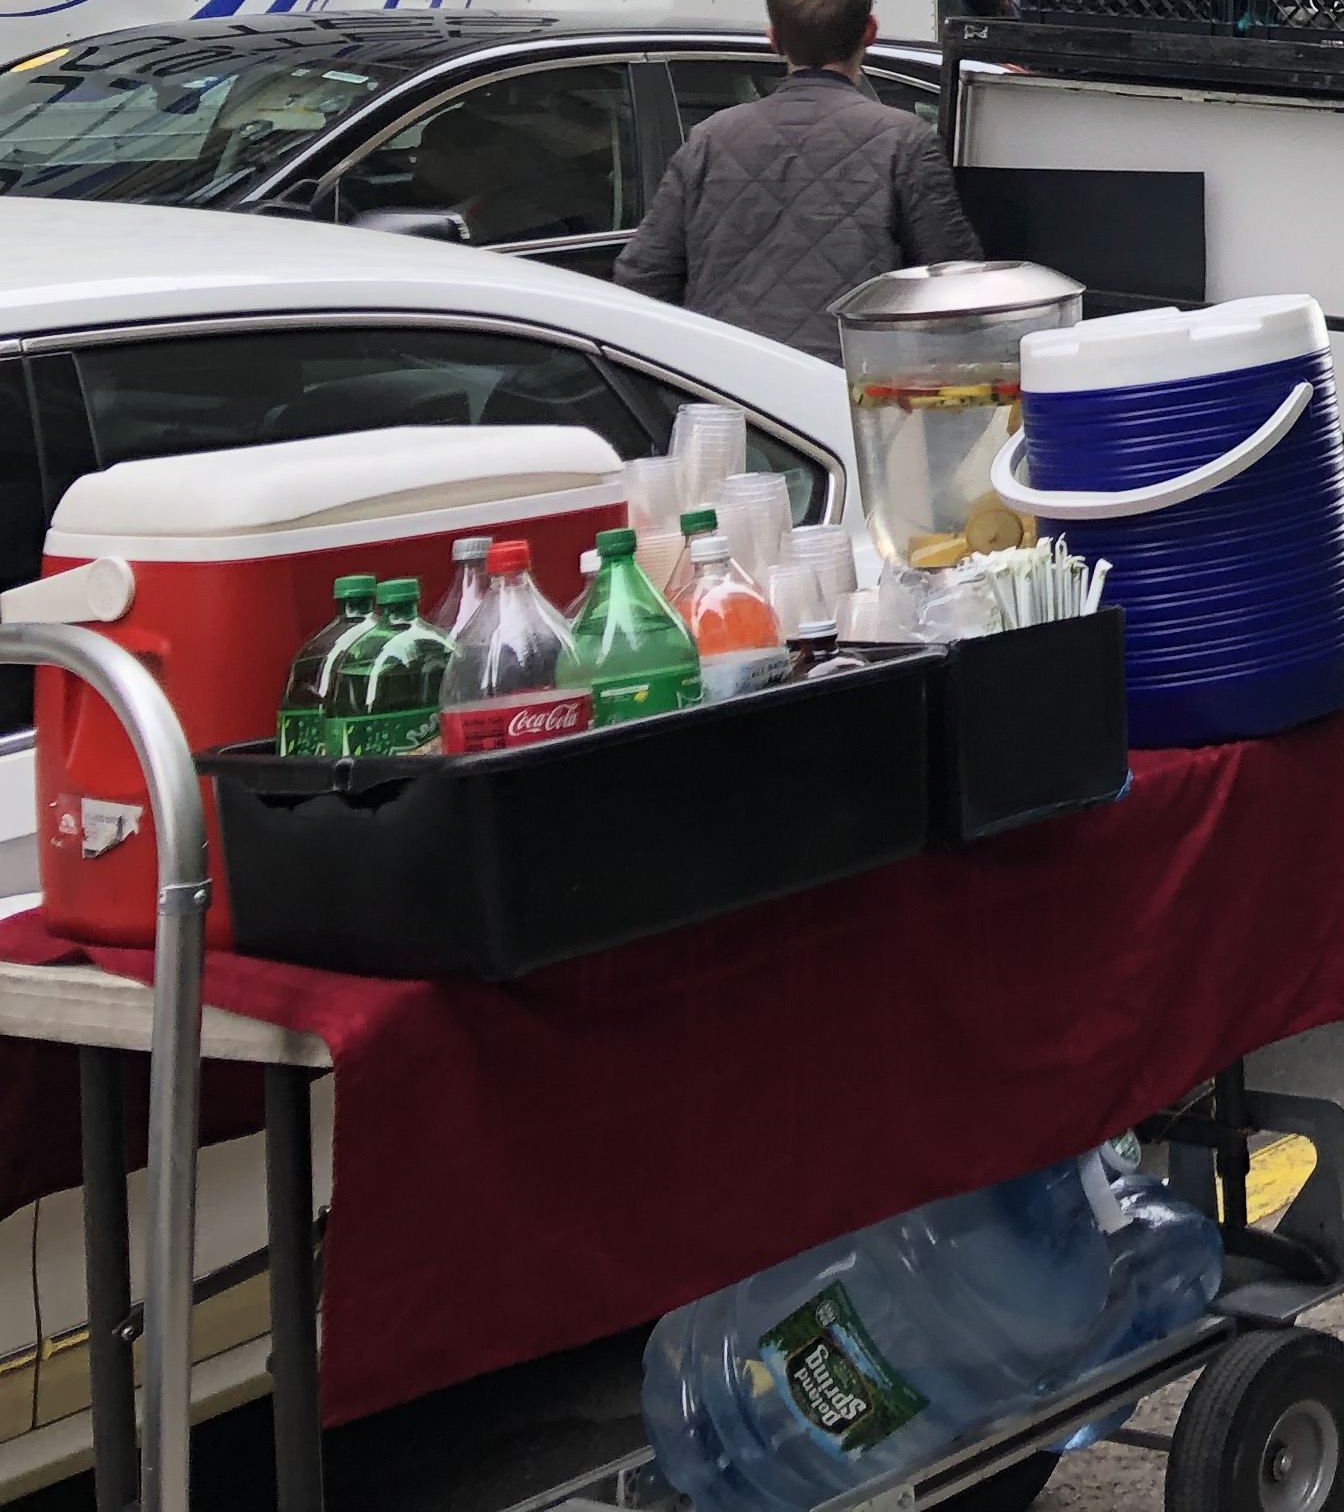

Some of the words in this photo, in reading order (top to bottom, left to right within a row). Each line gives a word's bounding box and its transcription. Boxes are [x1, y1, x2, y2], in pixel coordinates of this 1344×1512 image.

[507, 702, 582, 737] Coca-Cola
[794, 1367, 841, 1426] Poland
[805, 1344, 867, 1420] Spring
